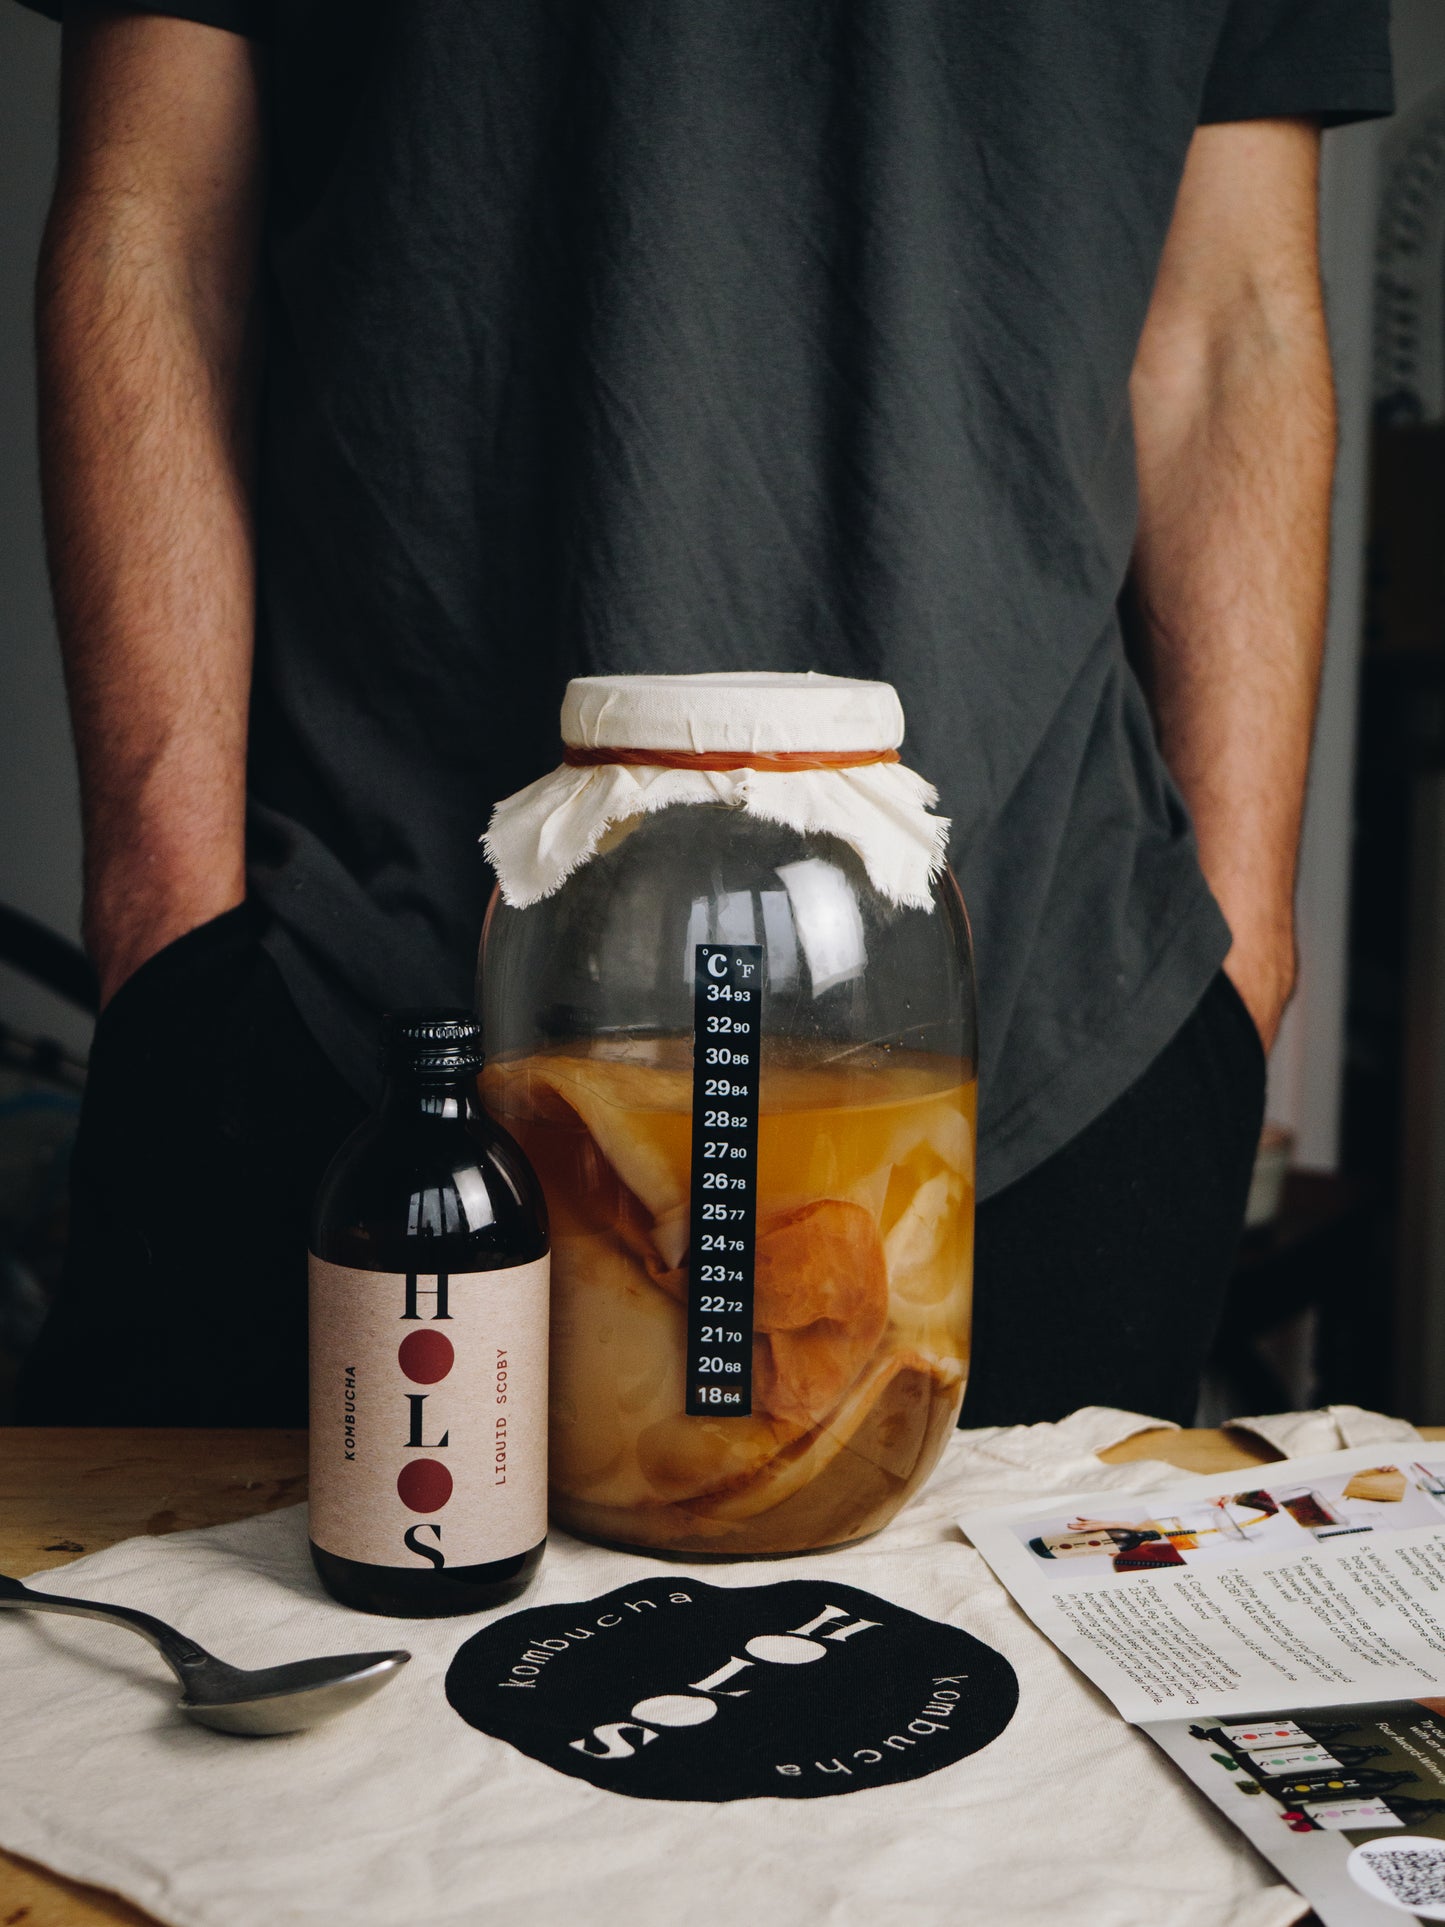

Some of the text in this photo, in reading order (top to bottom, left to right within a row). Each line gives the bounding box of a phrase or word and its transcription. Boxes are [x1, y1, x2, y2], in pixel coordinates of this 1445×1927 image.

[706, 984, 751, 1002] 34 93
[706, 1016, 750, 1034] 32 90
[705, 1047, 750, 1065] 30 86
[704, 1079, 749, 1097] 29 84
[704, 1110, 748, 1128] 28 82
[703, 1141, 747, 1159] 27 80
[702, 1172, 746, 1190] 26 78
[702, 1203, 746, 1221] 25 77
[700, 1234, 745, 1251] 24 76
[700, 1265, 744, 1282] 23 74
[699, 1295, 743, 1313] 22 72
[700, 1326, 743, 1343] 21 70
[698, 1356, 742, 1373] 20 68
[698, 1386, 741, 1404] 18 64
[344, 1366, 357, 1461] KOMBUCHA
[398, 1274, 455, 1569] HOLOS
[495, 1349, 508, 1486] LIQUID SCOBY
[498, 1592, 693, 1689] kombucha
[1425, 1637, 1445, 1653] suga
[568, 1604, 884, 1760] HOLOS
[775, 1674, 969, 1778] kombucha
